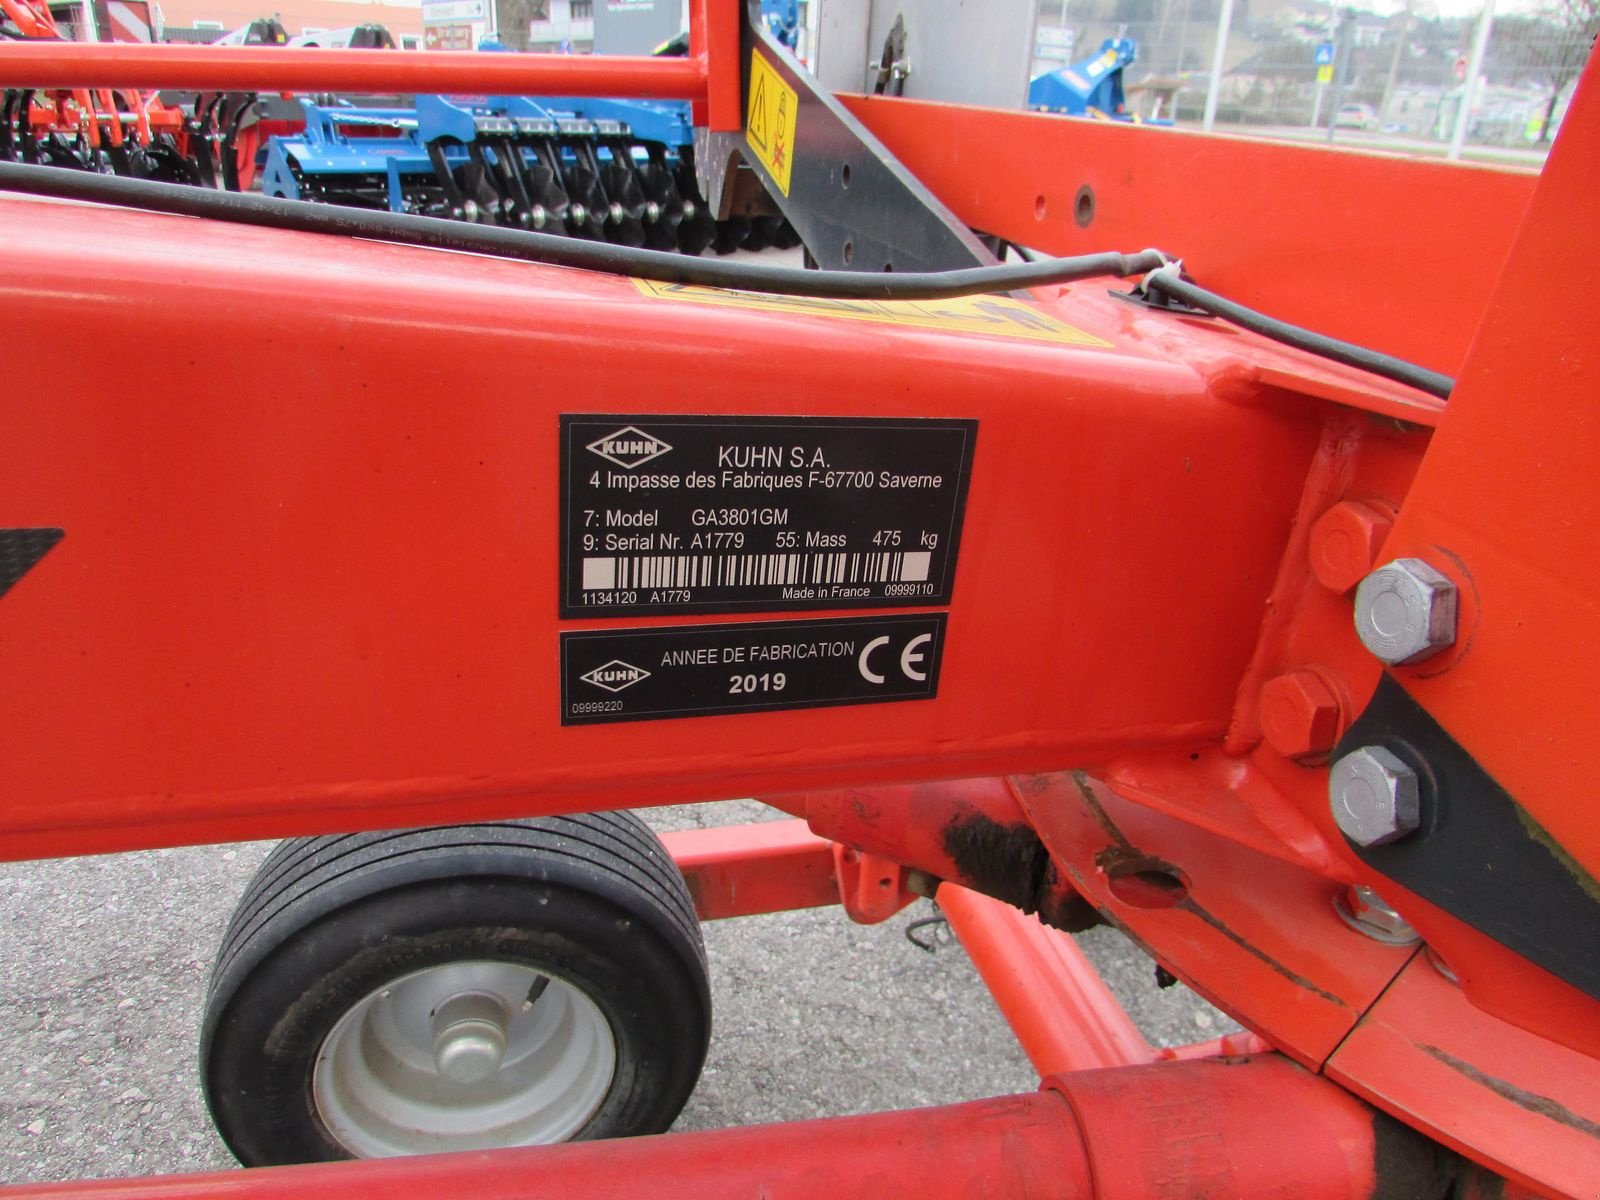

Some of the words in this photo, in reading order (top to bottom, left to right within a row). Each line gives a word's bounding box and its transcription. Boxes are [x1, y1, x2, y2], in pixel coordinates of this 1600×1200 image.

[602, 441, 659, 455] KUHN
[719, 446, 782, 467] KUHN
[790, 447, 830, 467] S.A.
[590, 471, 600, 488] 4
[608, 471, 680, 492] Impasse
[686, 471, 715, 488] des
[722, 471, 802, 492] Fabriques
[809, 471, 874, 488] F-67700
[879, 472, 942, 488] Saverne
[584, 510, 599, 527] 7:
[607, 510, 658, 526] Model
[692, 509, 788, 525] GA3801GM
[584, 534, 598, 551] 9:
[606, 534, 653, 550] Serial
[660, 533, 683, 549] Nr.
[691, 532, 744, 549] A1779
[776, 532, 799, 547] 55:
[806, 531, 846, 547] Mass
[873, 531, 901, 546] 475
[921, 530, 938, 549] kg
[583, 592, 636, 604] 1134120
[651, 590, 690, 602] A1779
[783, 587, 814, 599] Made
[818, 587, 827, 597] in
[832, 585, 870, 597] France
[884, 583, 933, 596] 09999110
[661, 649, 717, 666] ANNEE
[724, 648, 744, 662] DE
[750, 641, 854, 661] FABRICATION
[592, 671, 639, 682] KUHN
[729, 673, 786, 693] 2019
[572, 701, 623, 713] 09999220
